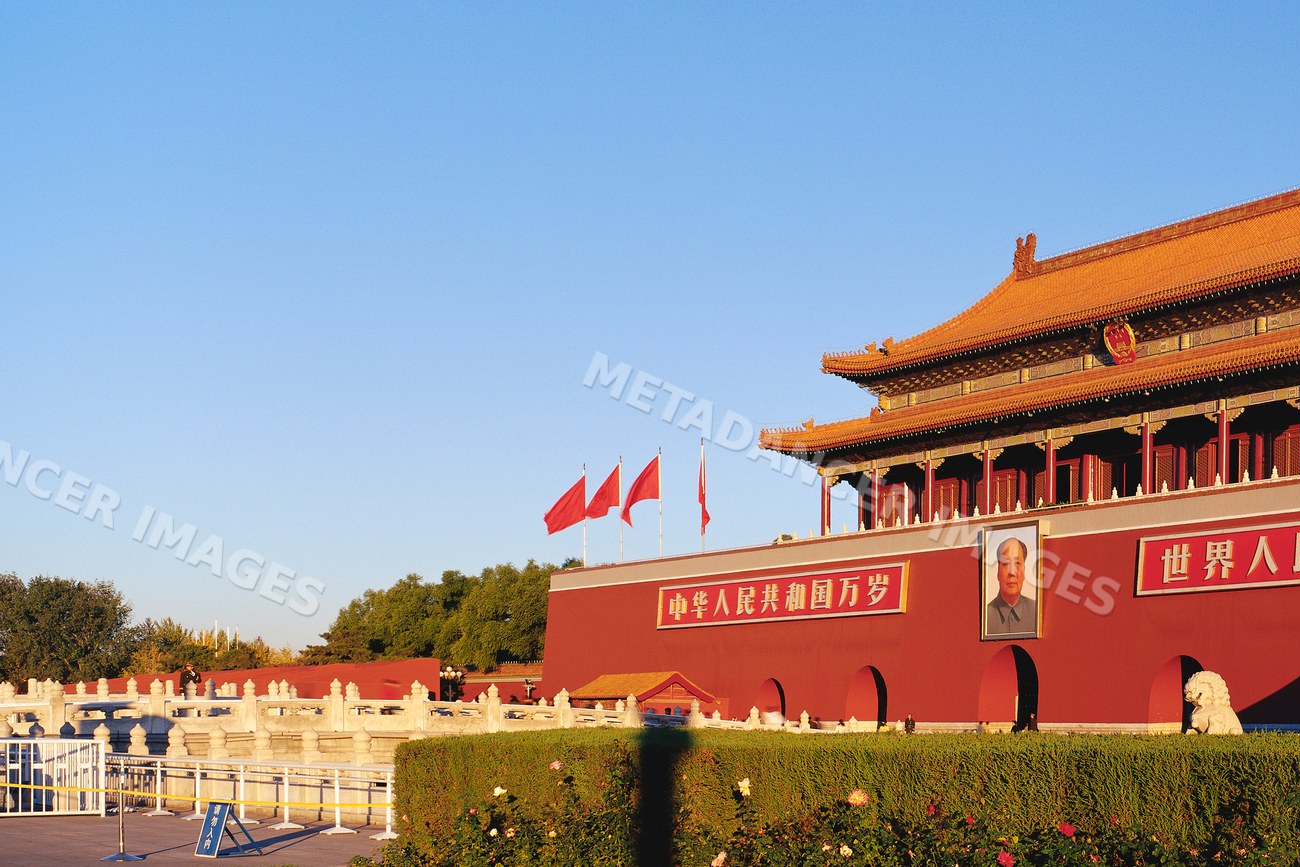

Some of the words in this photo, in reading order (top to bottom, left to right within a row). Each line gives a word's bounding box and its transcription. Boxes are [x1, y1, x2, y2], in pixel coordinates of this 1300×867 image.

[669, 573, 890, 621] 中华人民共和国万岁
